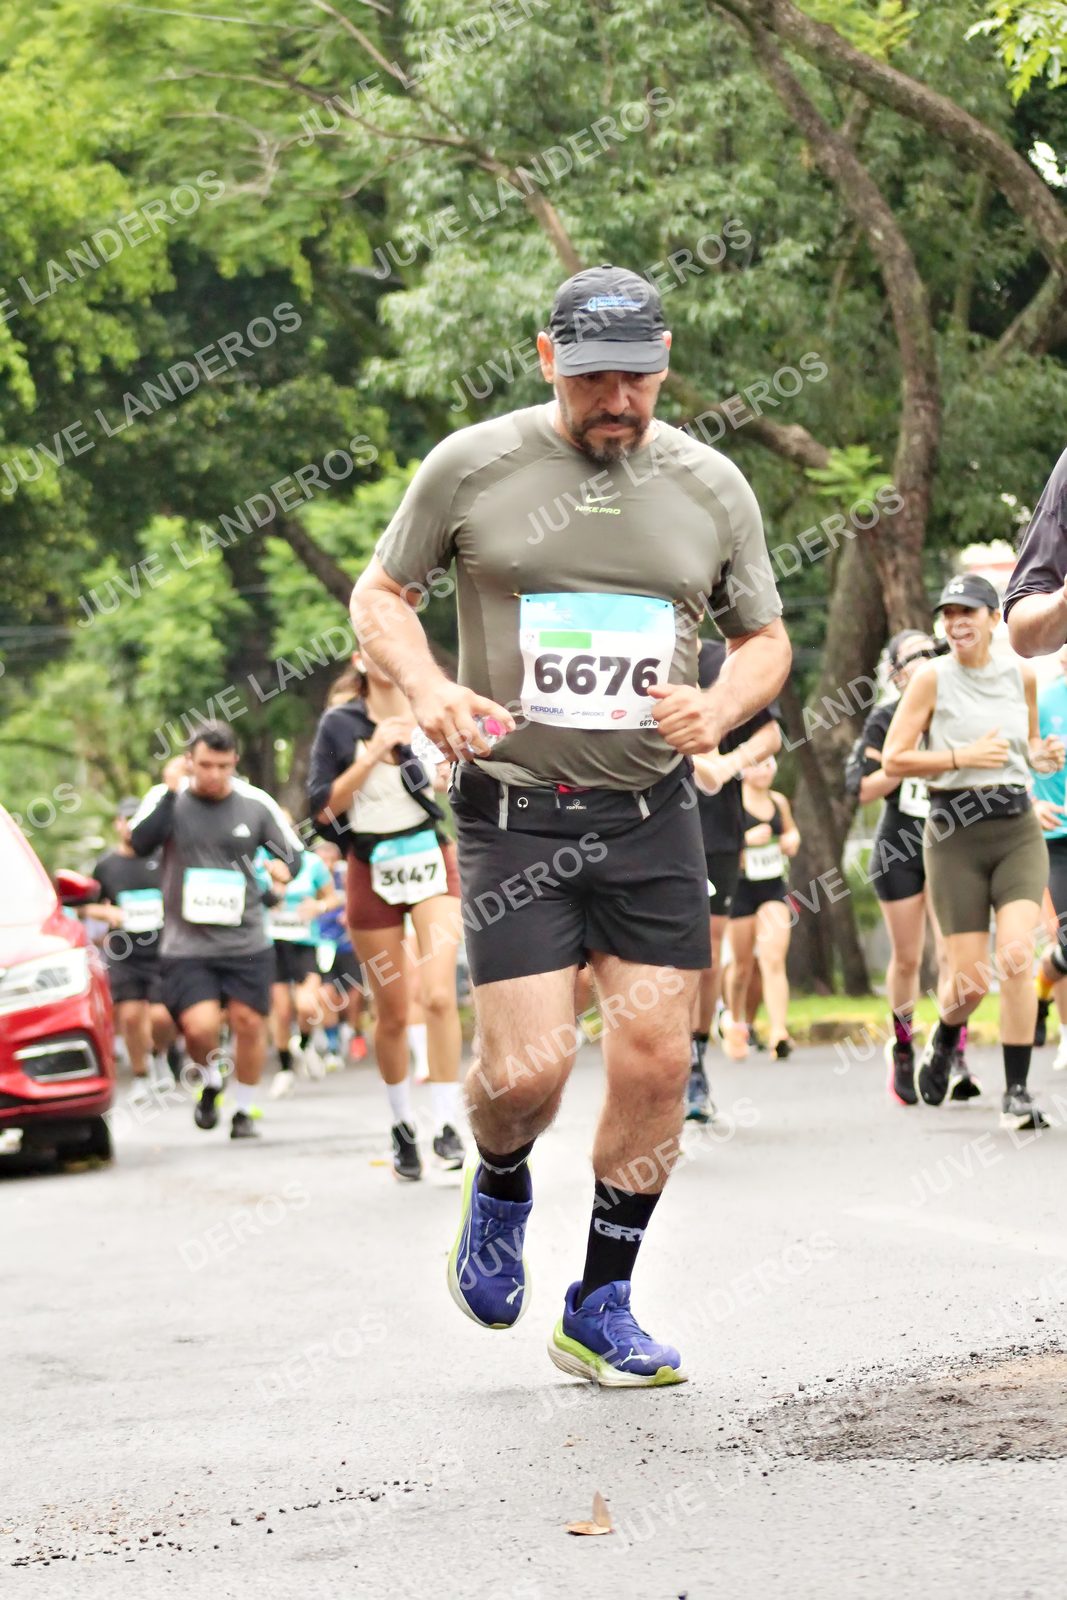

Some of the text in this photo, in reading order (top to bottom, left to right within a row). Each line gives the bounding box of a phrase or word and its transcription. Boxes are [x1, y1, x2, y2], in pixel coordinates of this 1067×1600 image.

[574, 505, 621, 515] NIKE PRO
[534, 653, 661, 697] 6676
[530, 705, 564, 715] PERDURA
[639, 719, 658, 727] 6676
